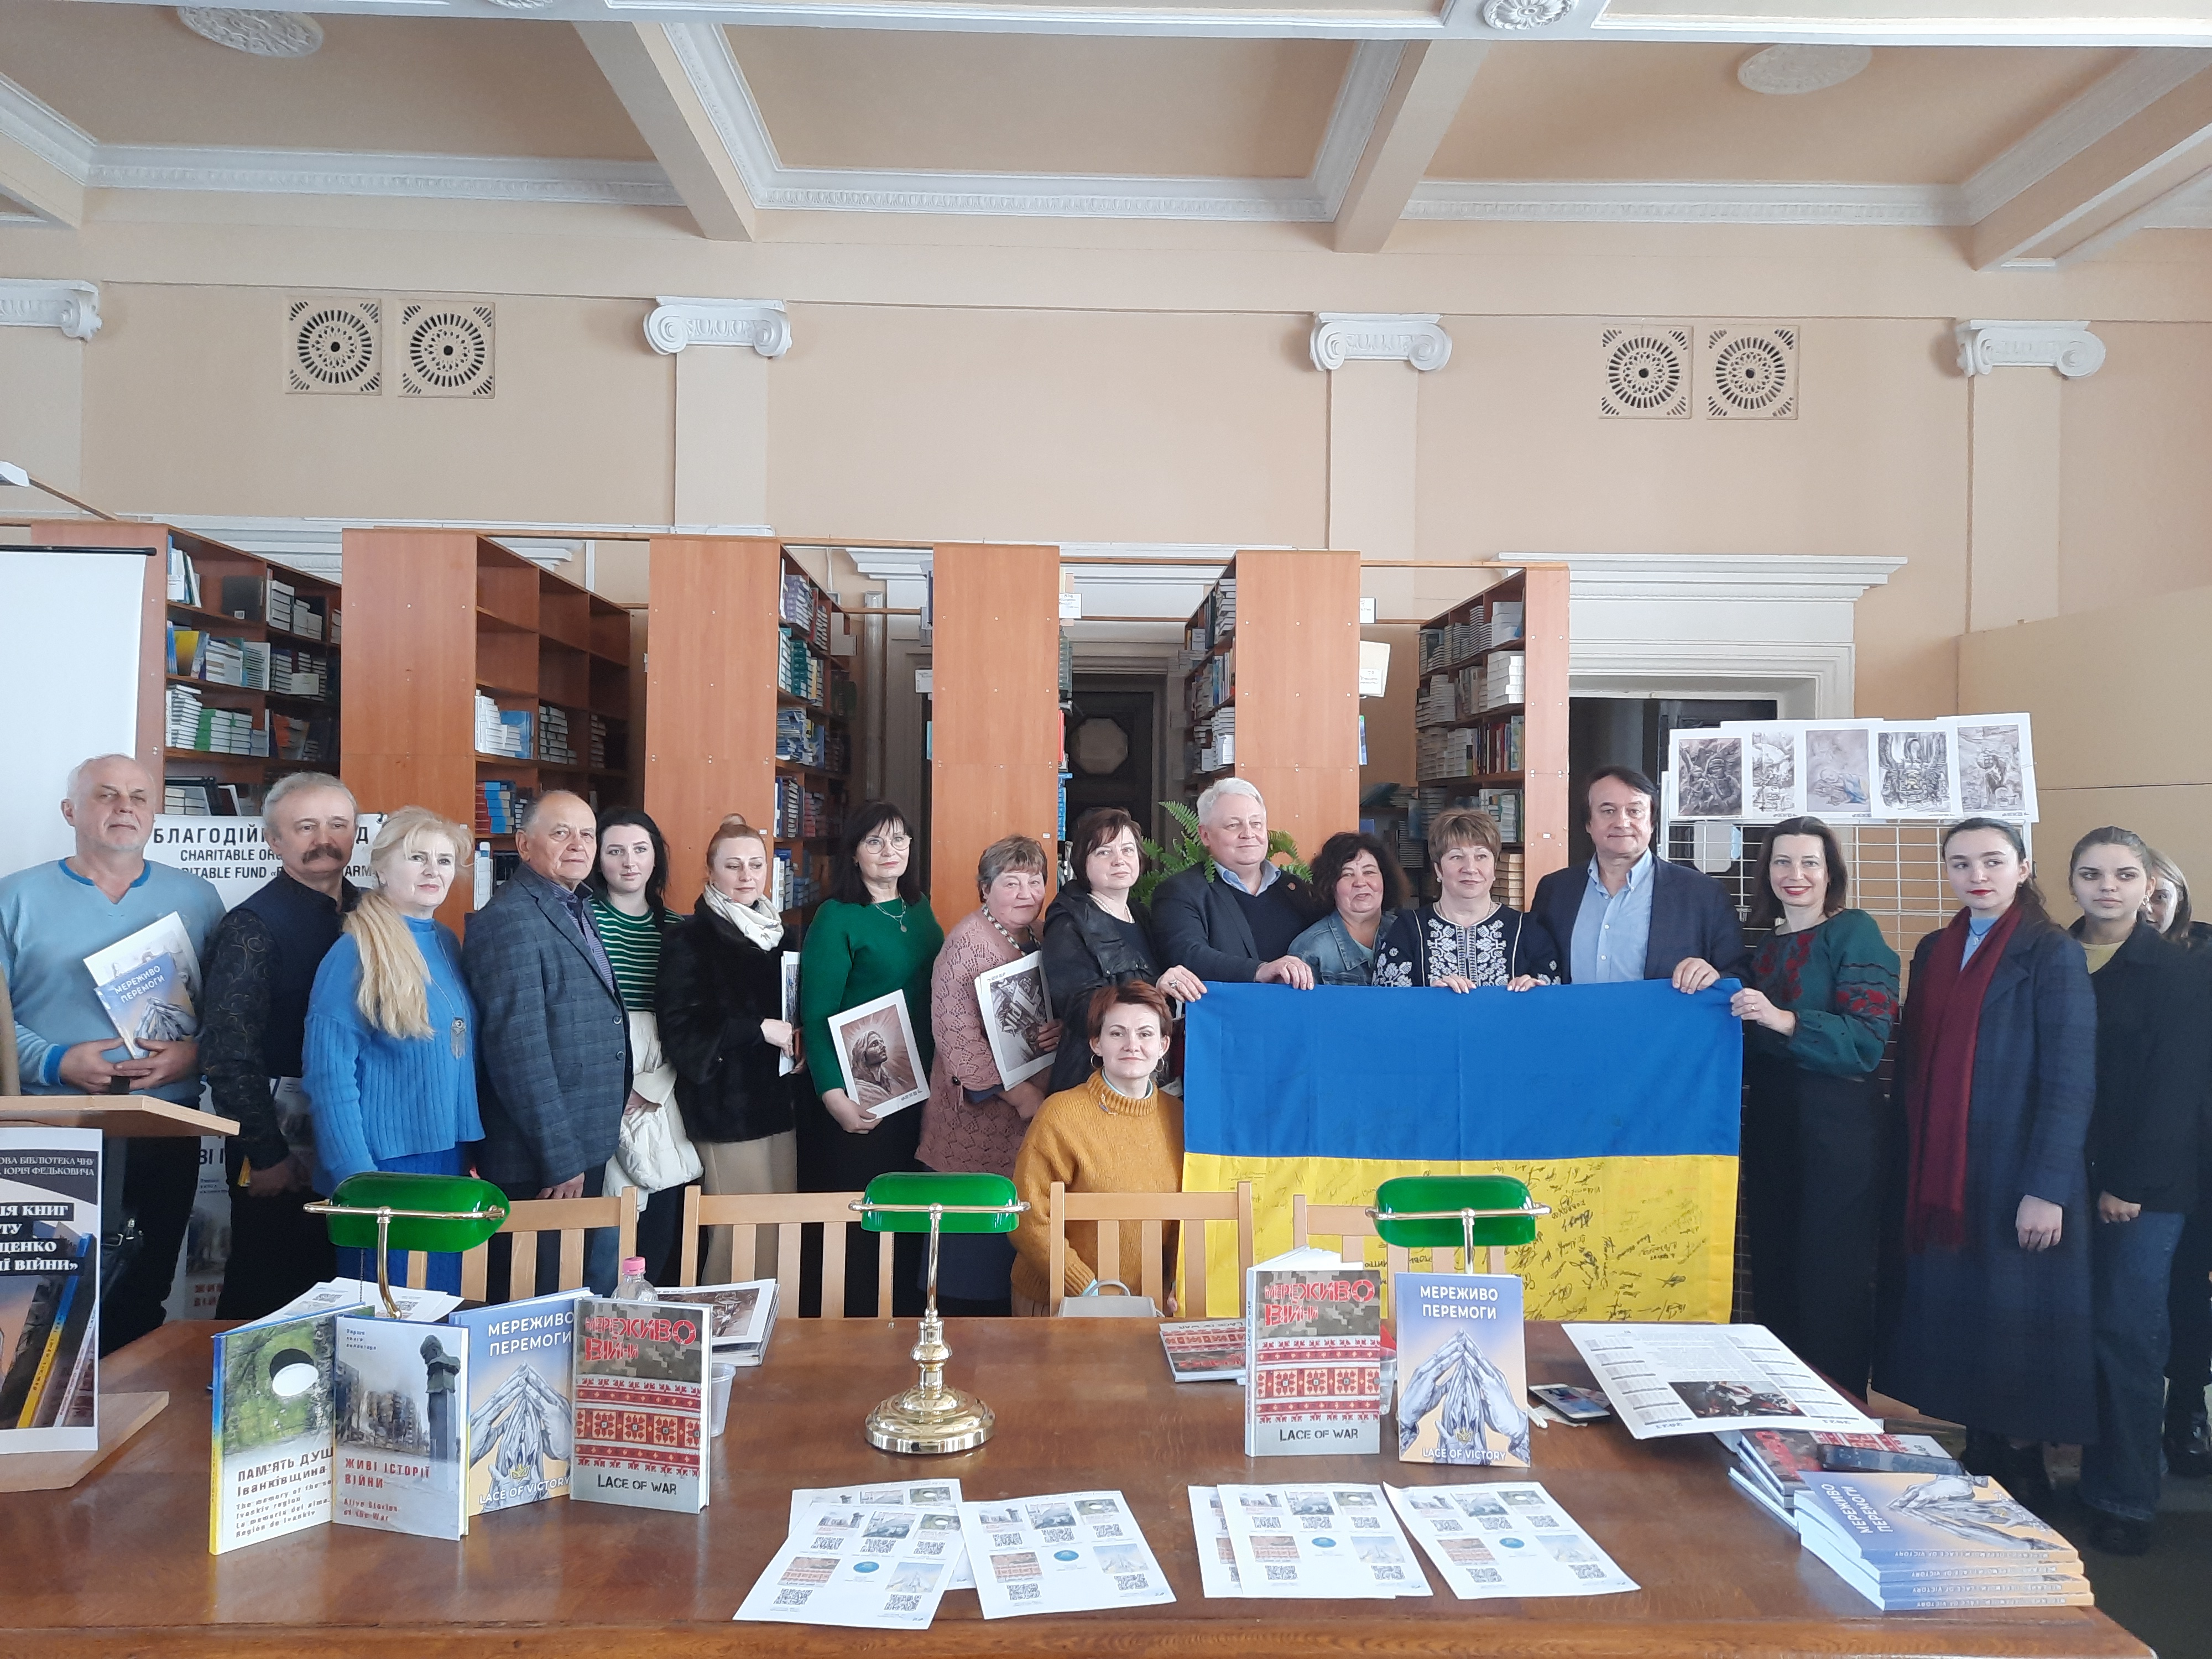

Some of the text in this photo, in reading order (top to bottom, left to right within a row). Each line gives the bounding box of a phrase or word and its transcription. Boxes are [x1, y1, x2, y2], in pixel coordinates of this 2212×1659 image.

[180, 849, 255, 861] CHARITABLE
[235, 867, 267, 878] FUND
[113, 965, 161, 995] МЕРЕЖИВО
[120, 974, 165, 1003] ПЕРЕМОГИ
[22, 1205, 68, 1216] КНИГ
[1265, 1279, 1375, 1302] МЕРЕЖИВО
[1420, 1285, 1499, 1301] МЕРЕЖИВО
[1265, 1301, 1318, 1326] ВІЙНИ
[1422, 1303, 1496, 1320] ПЕРЕМОГИ
[488, 1311, 574, 1337] МЕРЕЖИВО
[585, 1317, 697, 1345] МЕРЕЖИВО
[489, 1331, 572, 1357] ПЕРЕМОГИ
[585, 1336, 639, 1361] ВІЙНИ
[1279, 1428, 1359, 1441] LACE OF WAR
[300, 1447, 333, 1467] ДУШ
[1422, 1447, 1506, 1462] LACE OF VICTORY
[345, 1458, 430, 1478] ЖИВІ ІСТОРІЇ
[237, 1465, 326, 1497] Іванківщина
[345, 1474, 383, 1488] ВІЙНИ
[479, 1475, 571, 1504] LACE OF VICTORY
[598, 1474, 677, 1495] LACE OF WAR
[1820, 1484, 1874, 1533] МЕРЕЖИВО
[1841, 1486, 1893, 1532] ПЕРЕМОГИ
